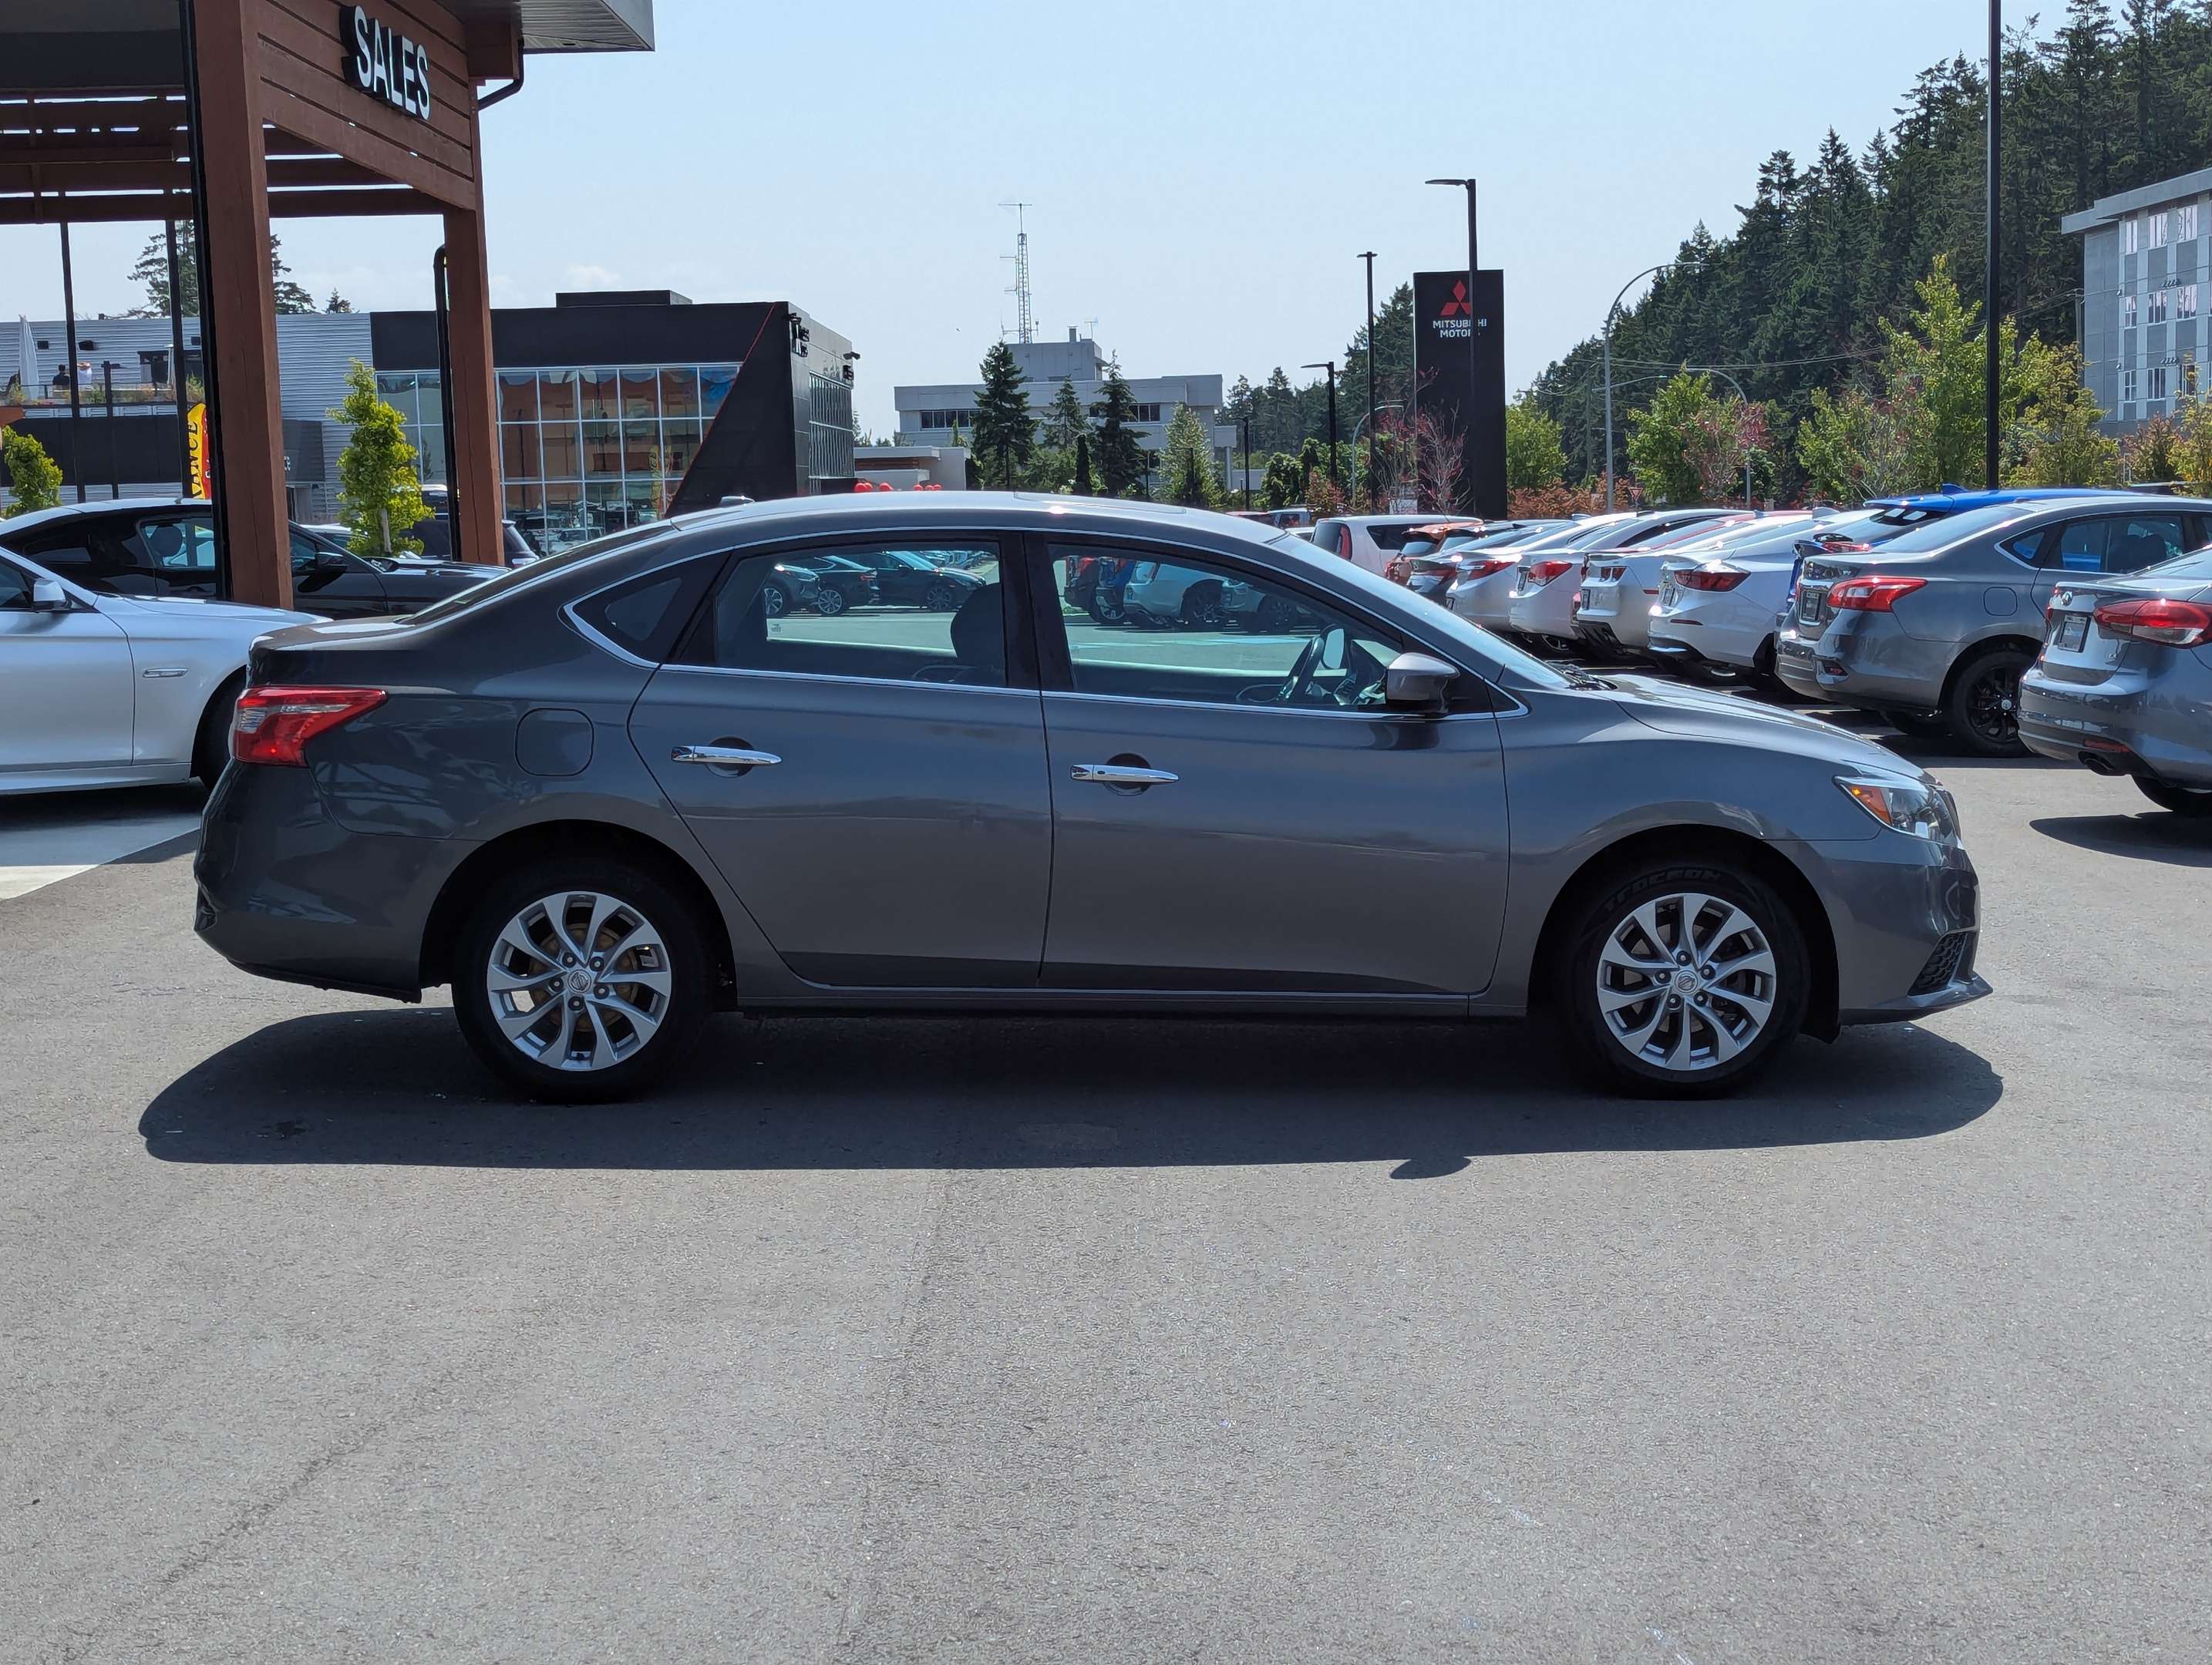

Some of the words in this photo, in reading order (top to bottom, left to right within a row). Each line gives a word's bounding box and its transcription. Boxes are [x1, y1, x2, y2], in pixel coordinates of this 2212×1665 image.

[353, 5, 430, 120] SALES
[1433, 318, 1487, 329] MITSUBIHI
[1439, 328, 1481, 338] MOTO
